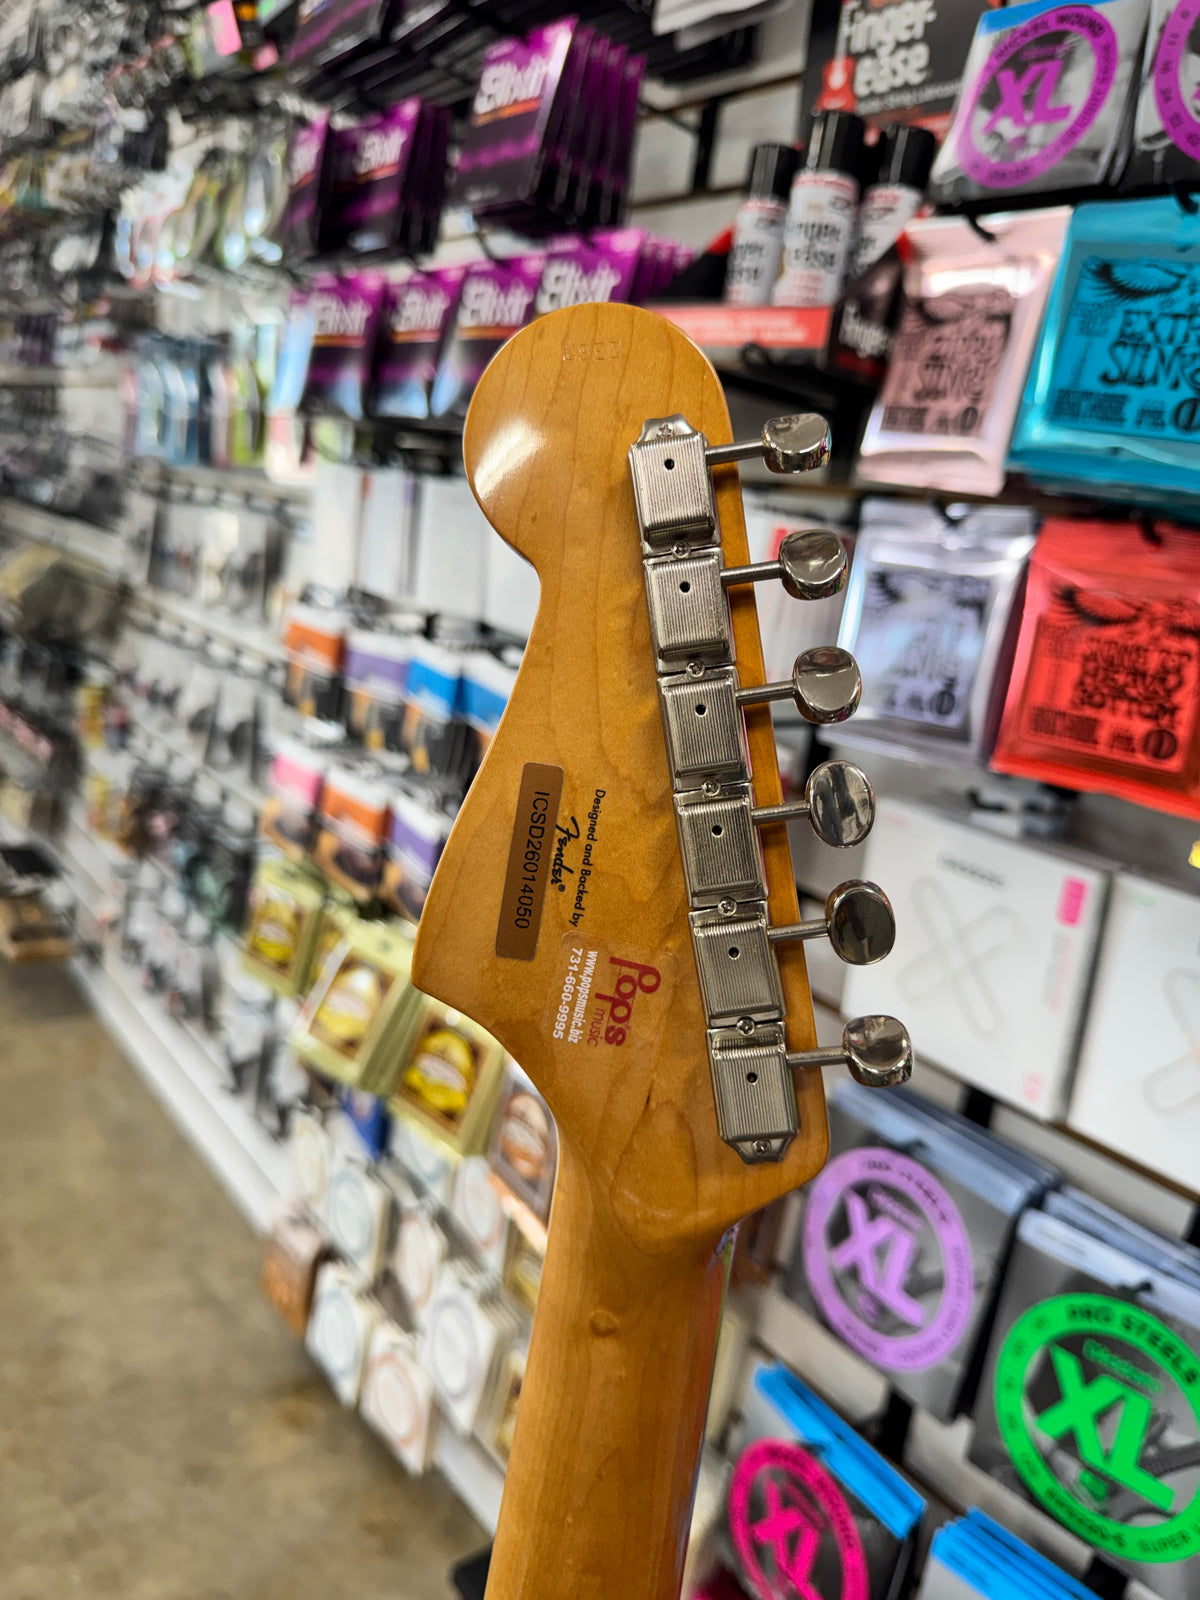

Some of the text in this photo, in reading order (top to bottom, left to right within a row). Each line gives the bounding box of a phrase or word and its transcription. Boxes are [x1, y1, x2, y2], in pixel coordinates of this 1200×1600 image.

[983, 59, 1072, 137] XL
[514, 790, 550, 930] ICSD26014050
[568, 789, 606, 928] Designed and Backed by
[552, 947, 583, 1040] 731-660-9995
[567, 950, 599, 1045] www.popsmusic.biz
[831, 1186, 926, 1329] XL
[1035, 1341, 1176, 1514] XL
